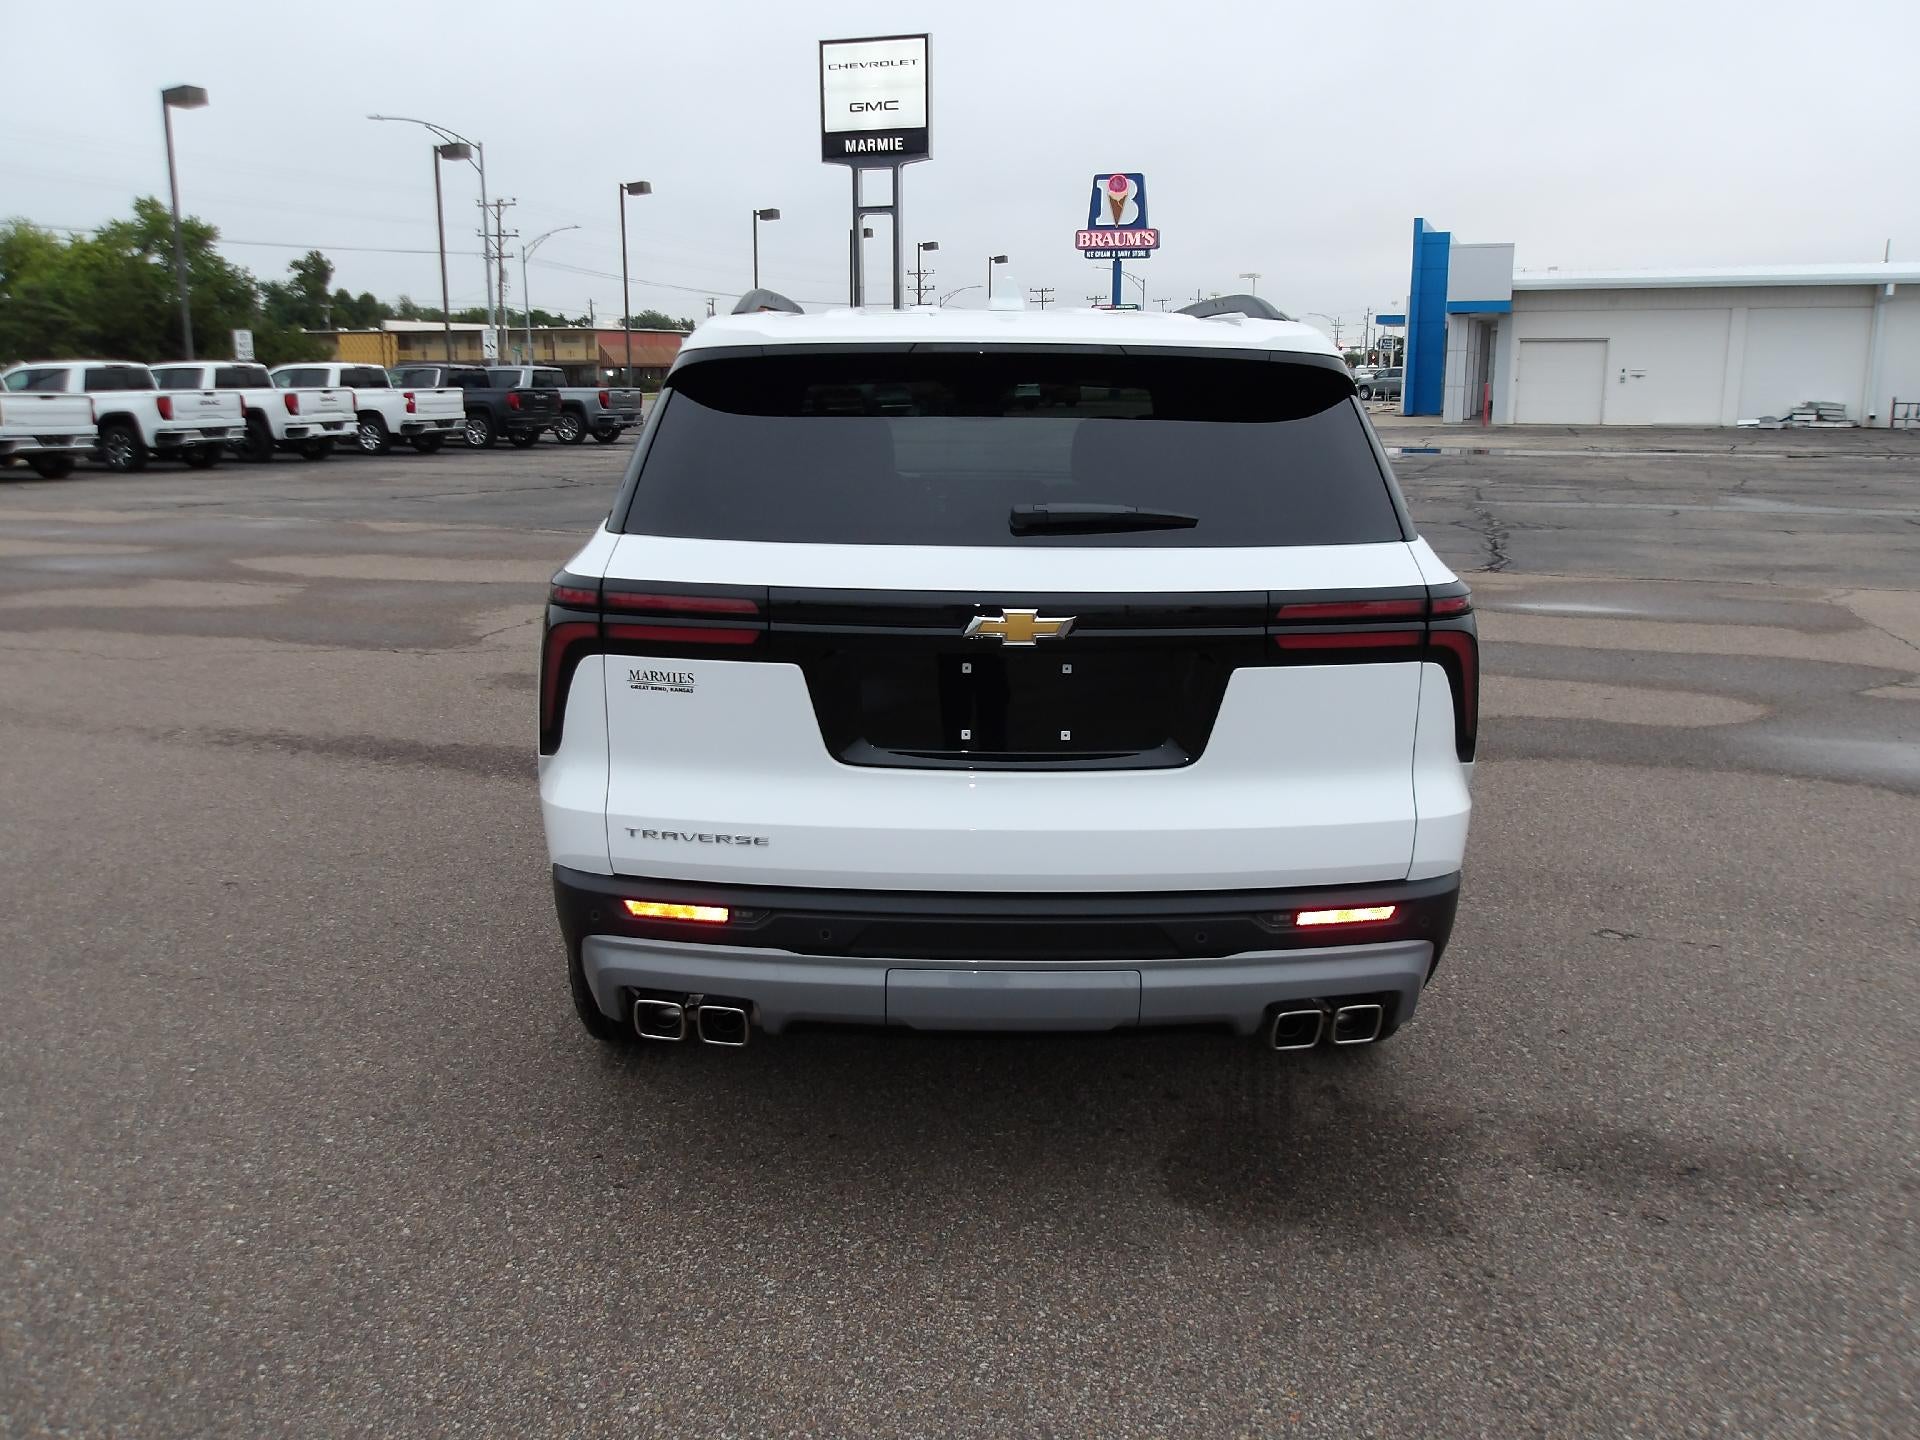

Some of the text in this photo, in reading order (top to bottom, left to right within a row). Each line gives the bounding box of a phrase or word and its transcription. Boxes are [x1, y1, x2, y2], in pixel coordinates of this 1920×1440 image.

[828, 58, 918, 71] CHEVROLET
[849, 100, 899, 113] GMC
[845, 137, 904, 153] MARMIE
[1078, 231, 1155, 247] BRAUM'S
[629, 669, 695, 684] MARMIES
[624, 827, 770, 847] TRAVERSE
